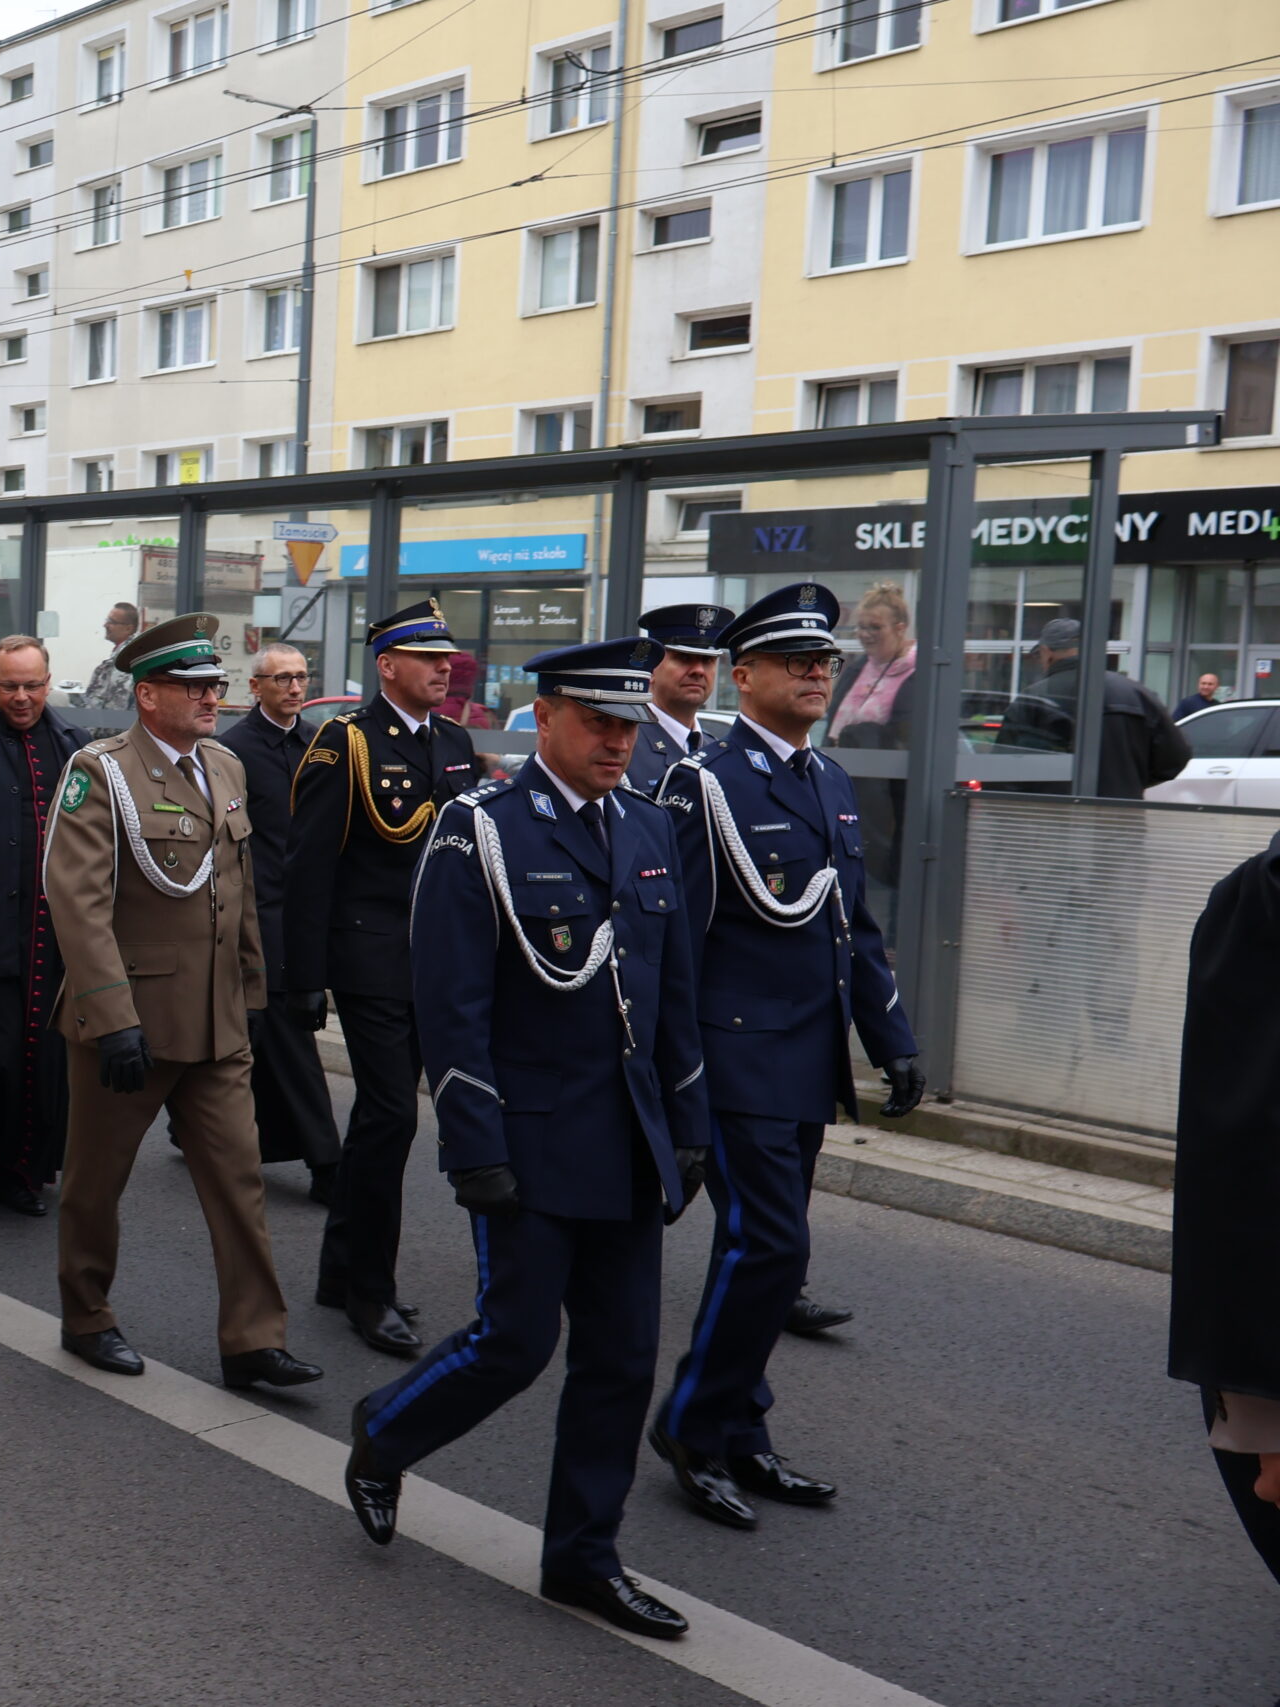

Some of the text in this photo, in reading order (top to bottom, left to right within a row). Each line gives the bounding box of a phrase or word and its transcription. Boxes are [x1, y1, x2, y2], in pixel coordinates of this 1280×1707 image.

[855, 521, 926, 550] SKLE
[478, 549, 513, 564] Więcej
[532, 546, 567, 560] szkoła
